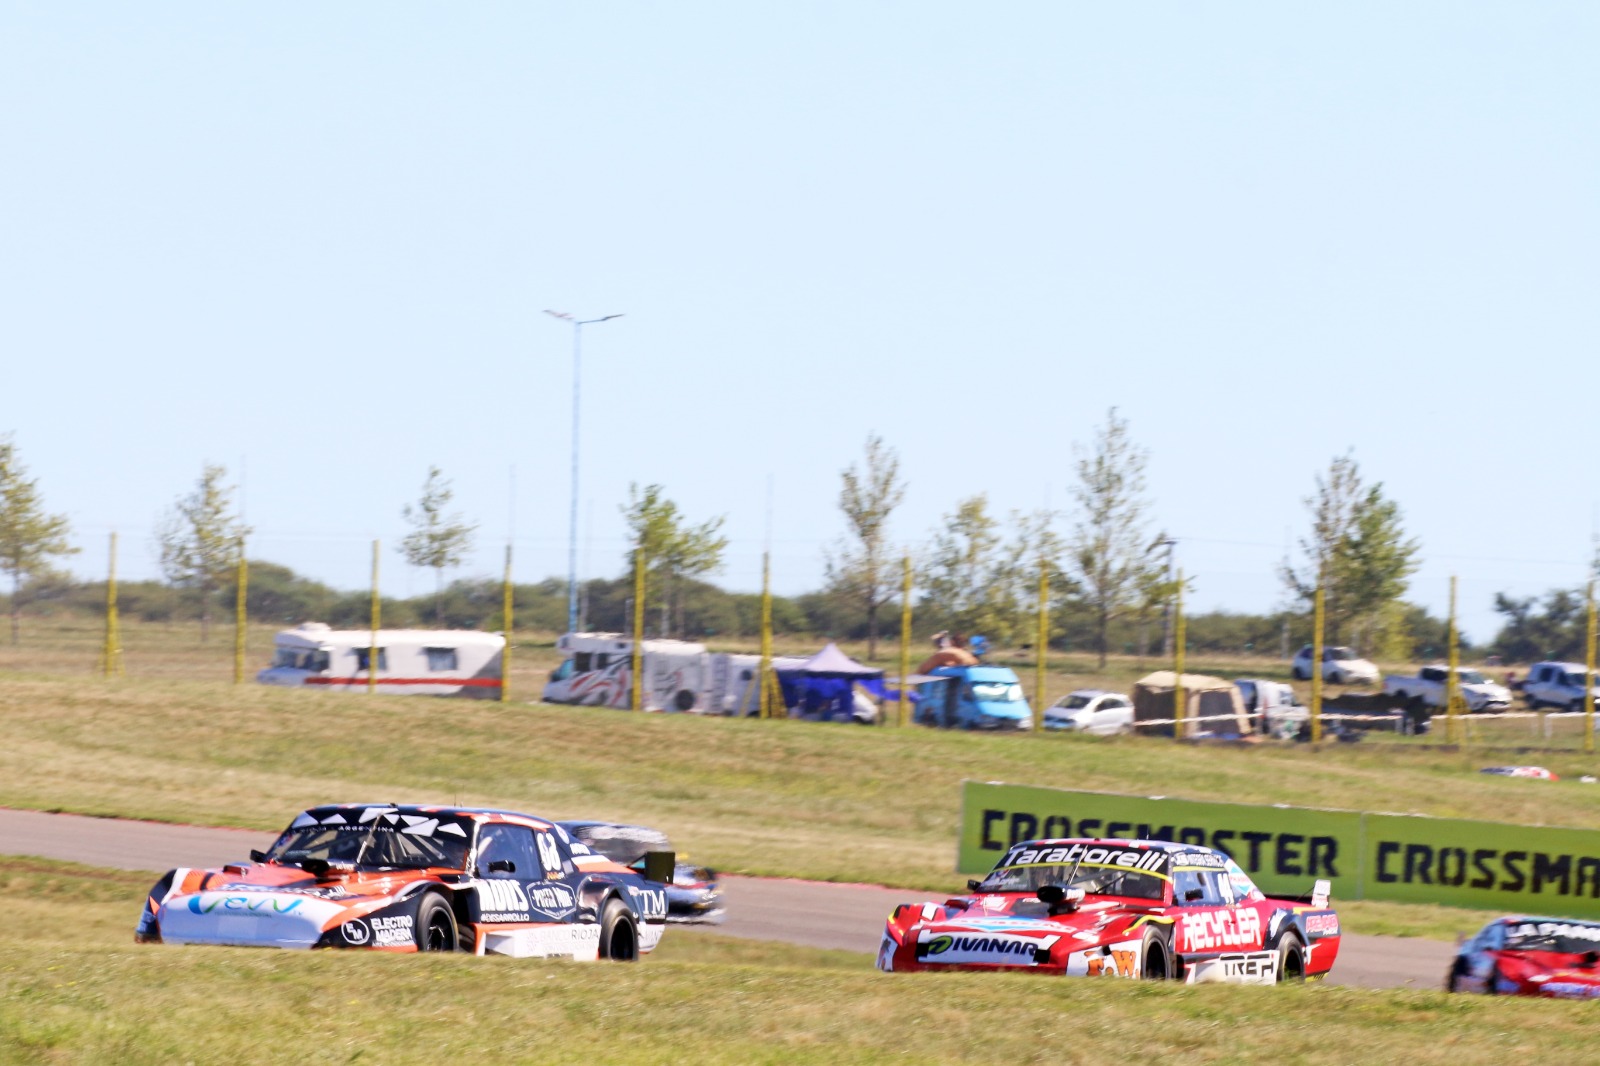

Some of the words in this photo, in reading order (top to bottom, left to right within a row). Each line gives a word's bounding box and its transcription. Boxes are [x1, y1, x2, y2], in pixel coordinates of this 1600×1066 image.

[338, 825, 394, 833] ARGENINA
[640, 890, 666, 915] TM
[371, 915, 413, 930] ELECTRO
